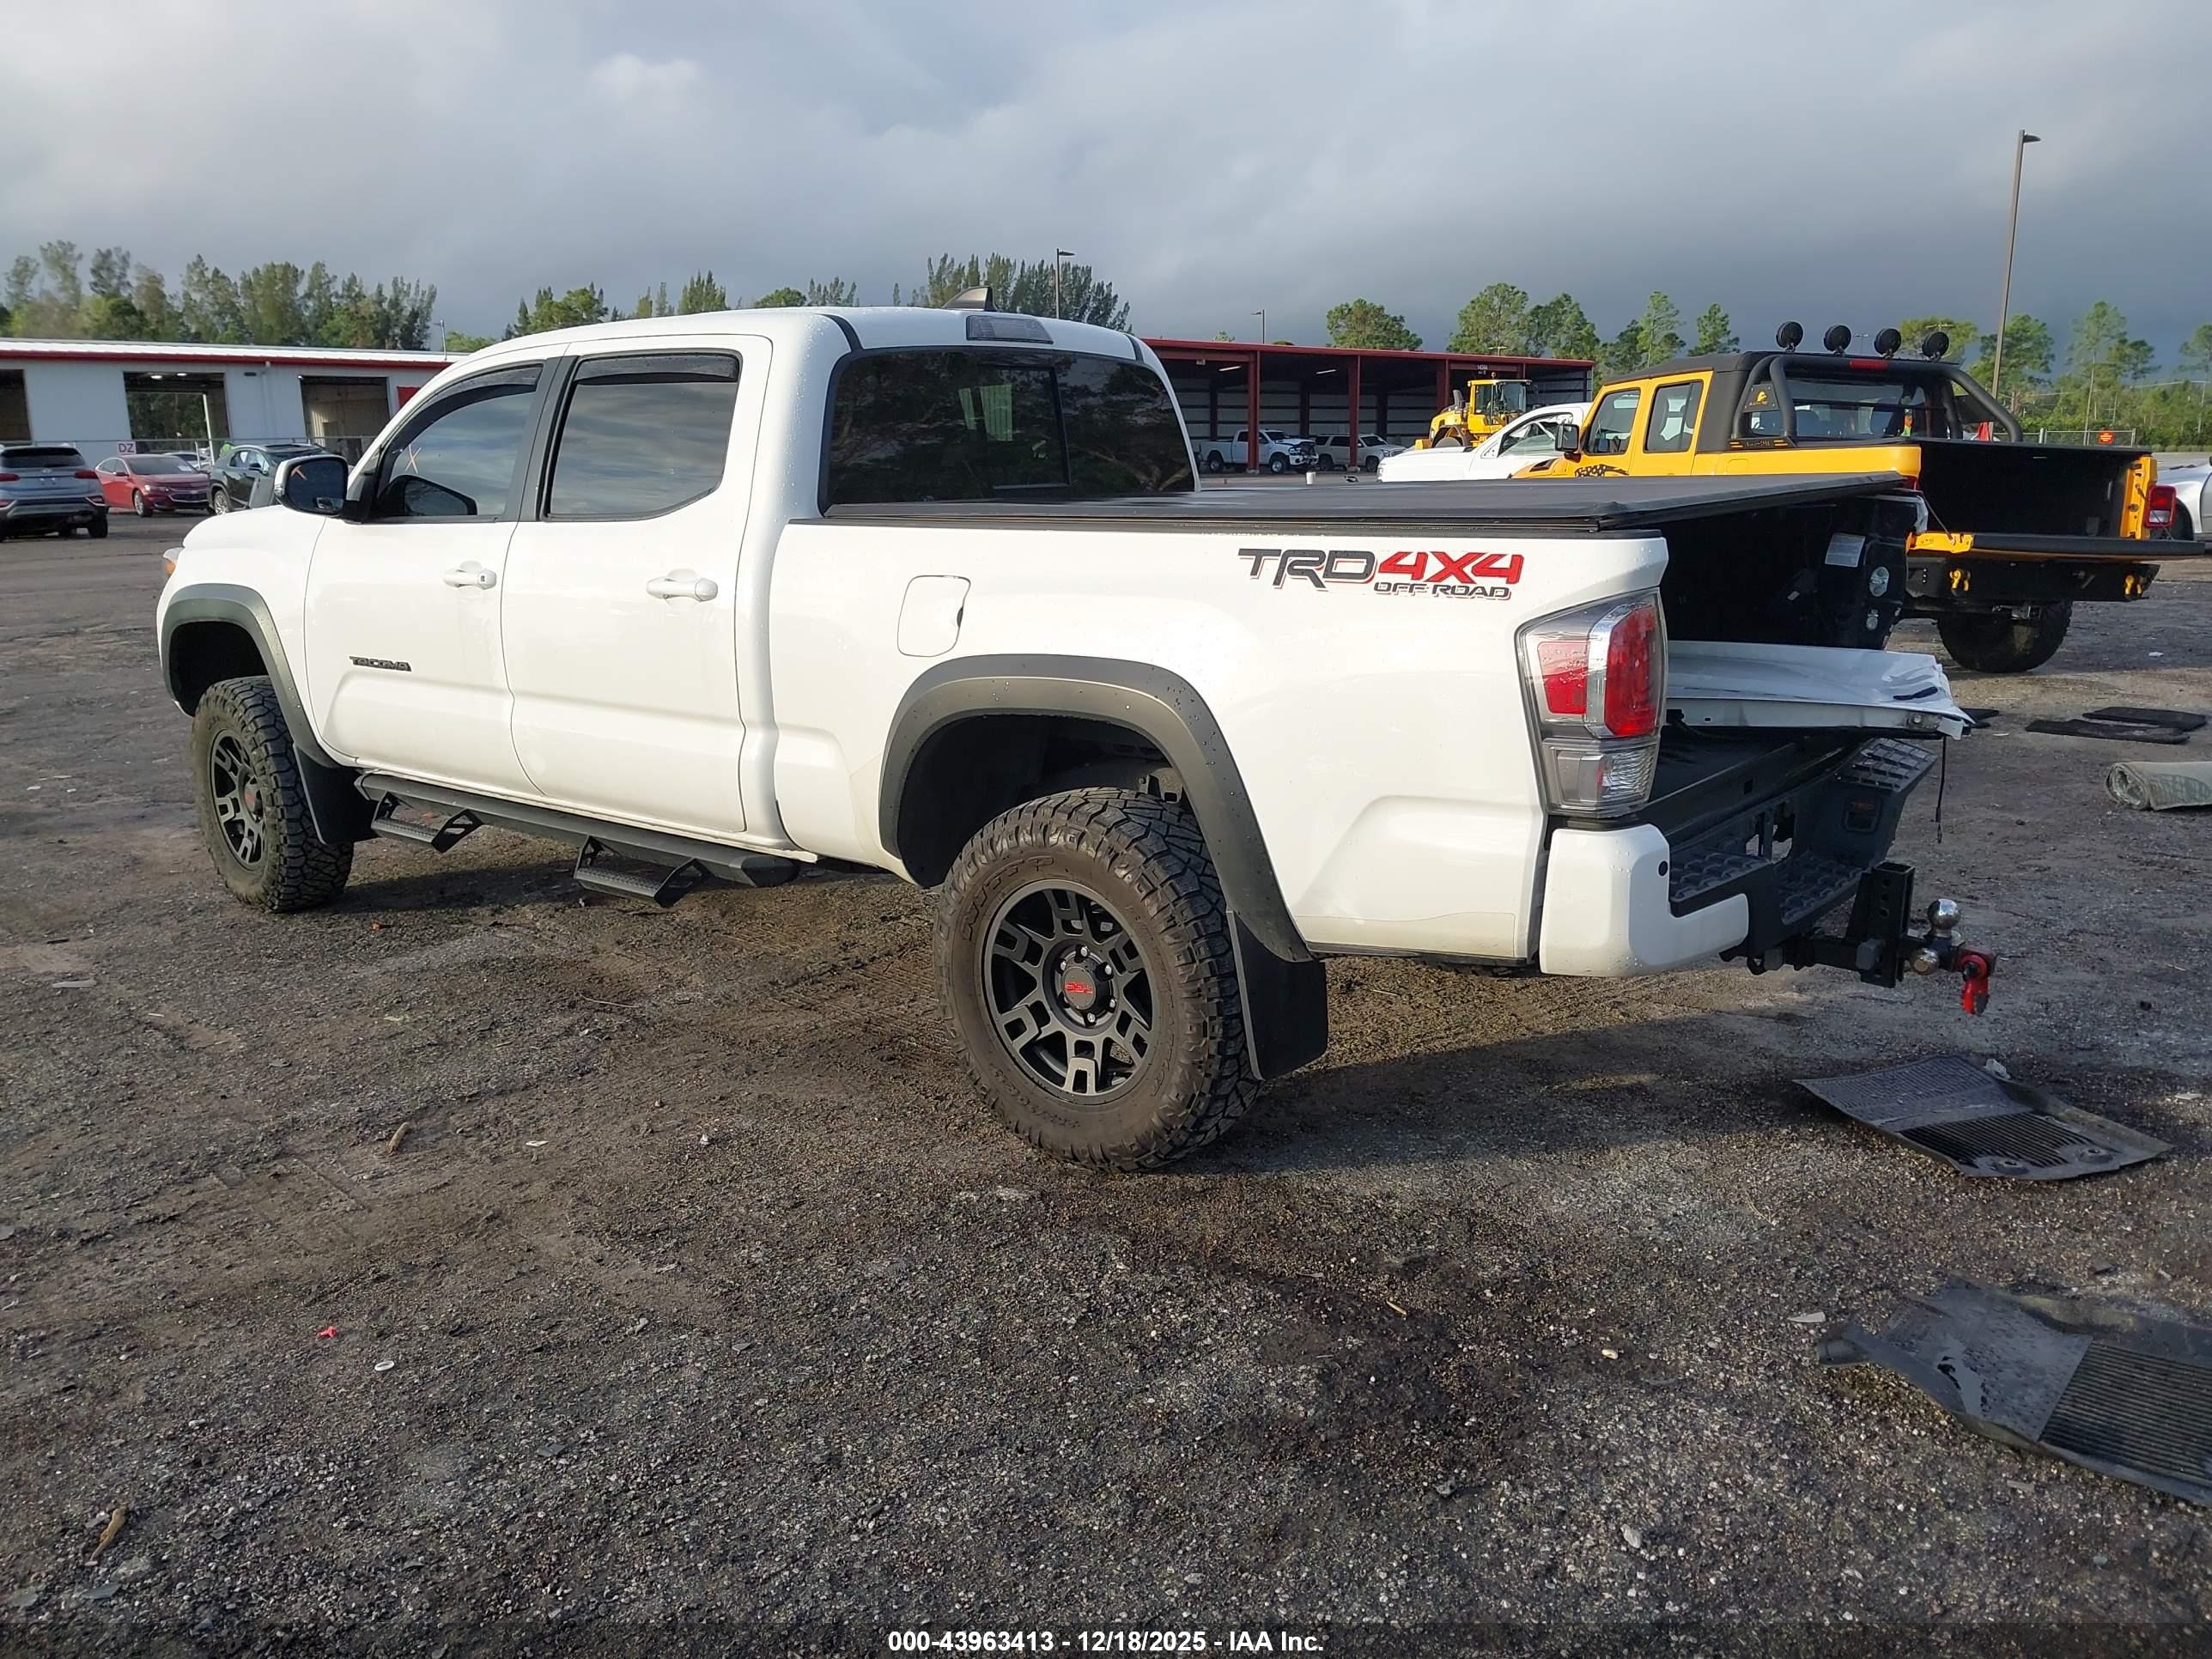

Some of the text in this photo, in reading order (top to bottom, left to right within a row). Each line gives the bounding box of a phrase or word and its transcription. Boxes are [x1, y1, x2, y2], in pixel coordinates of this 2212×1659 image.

[118, 443, 135, 453] DZ
[1238, 548, 1376, 590] TRD
[1373, 580, 1512, 600] OFF ROAD
[349, 655, 412, 672] TACOMA
